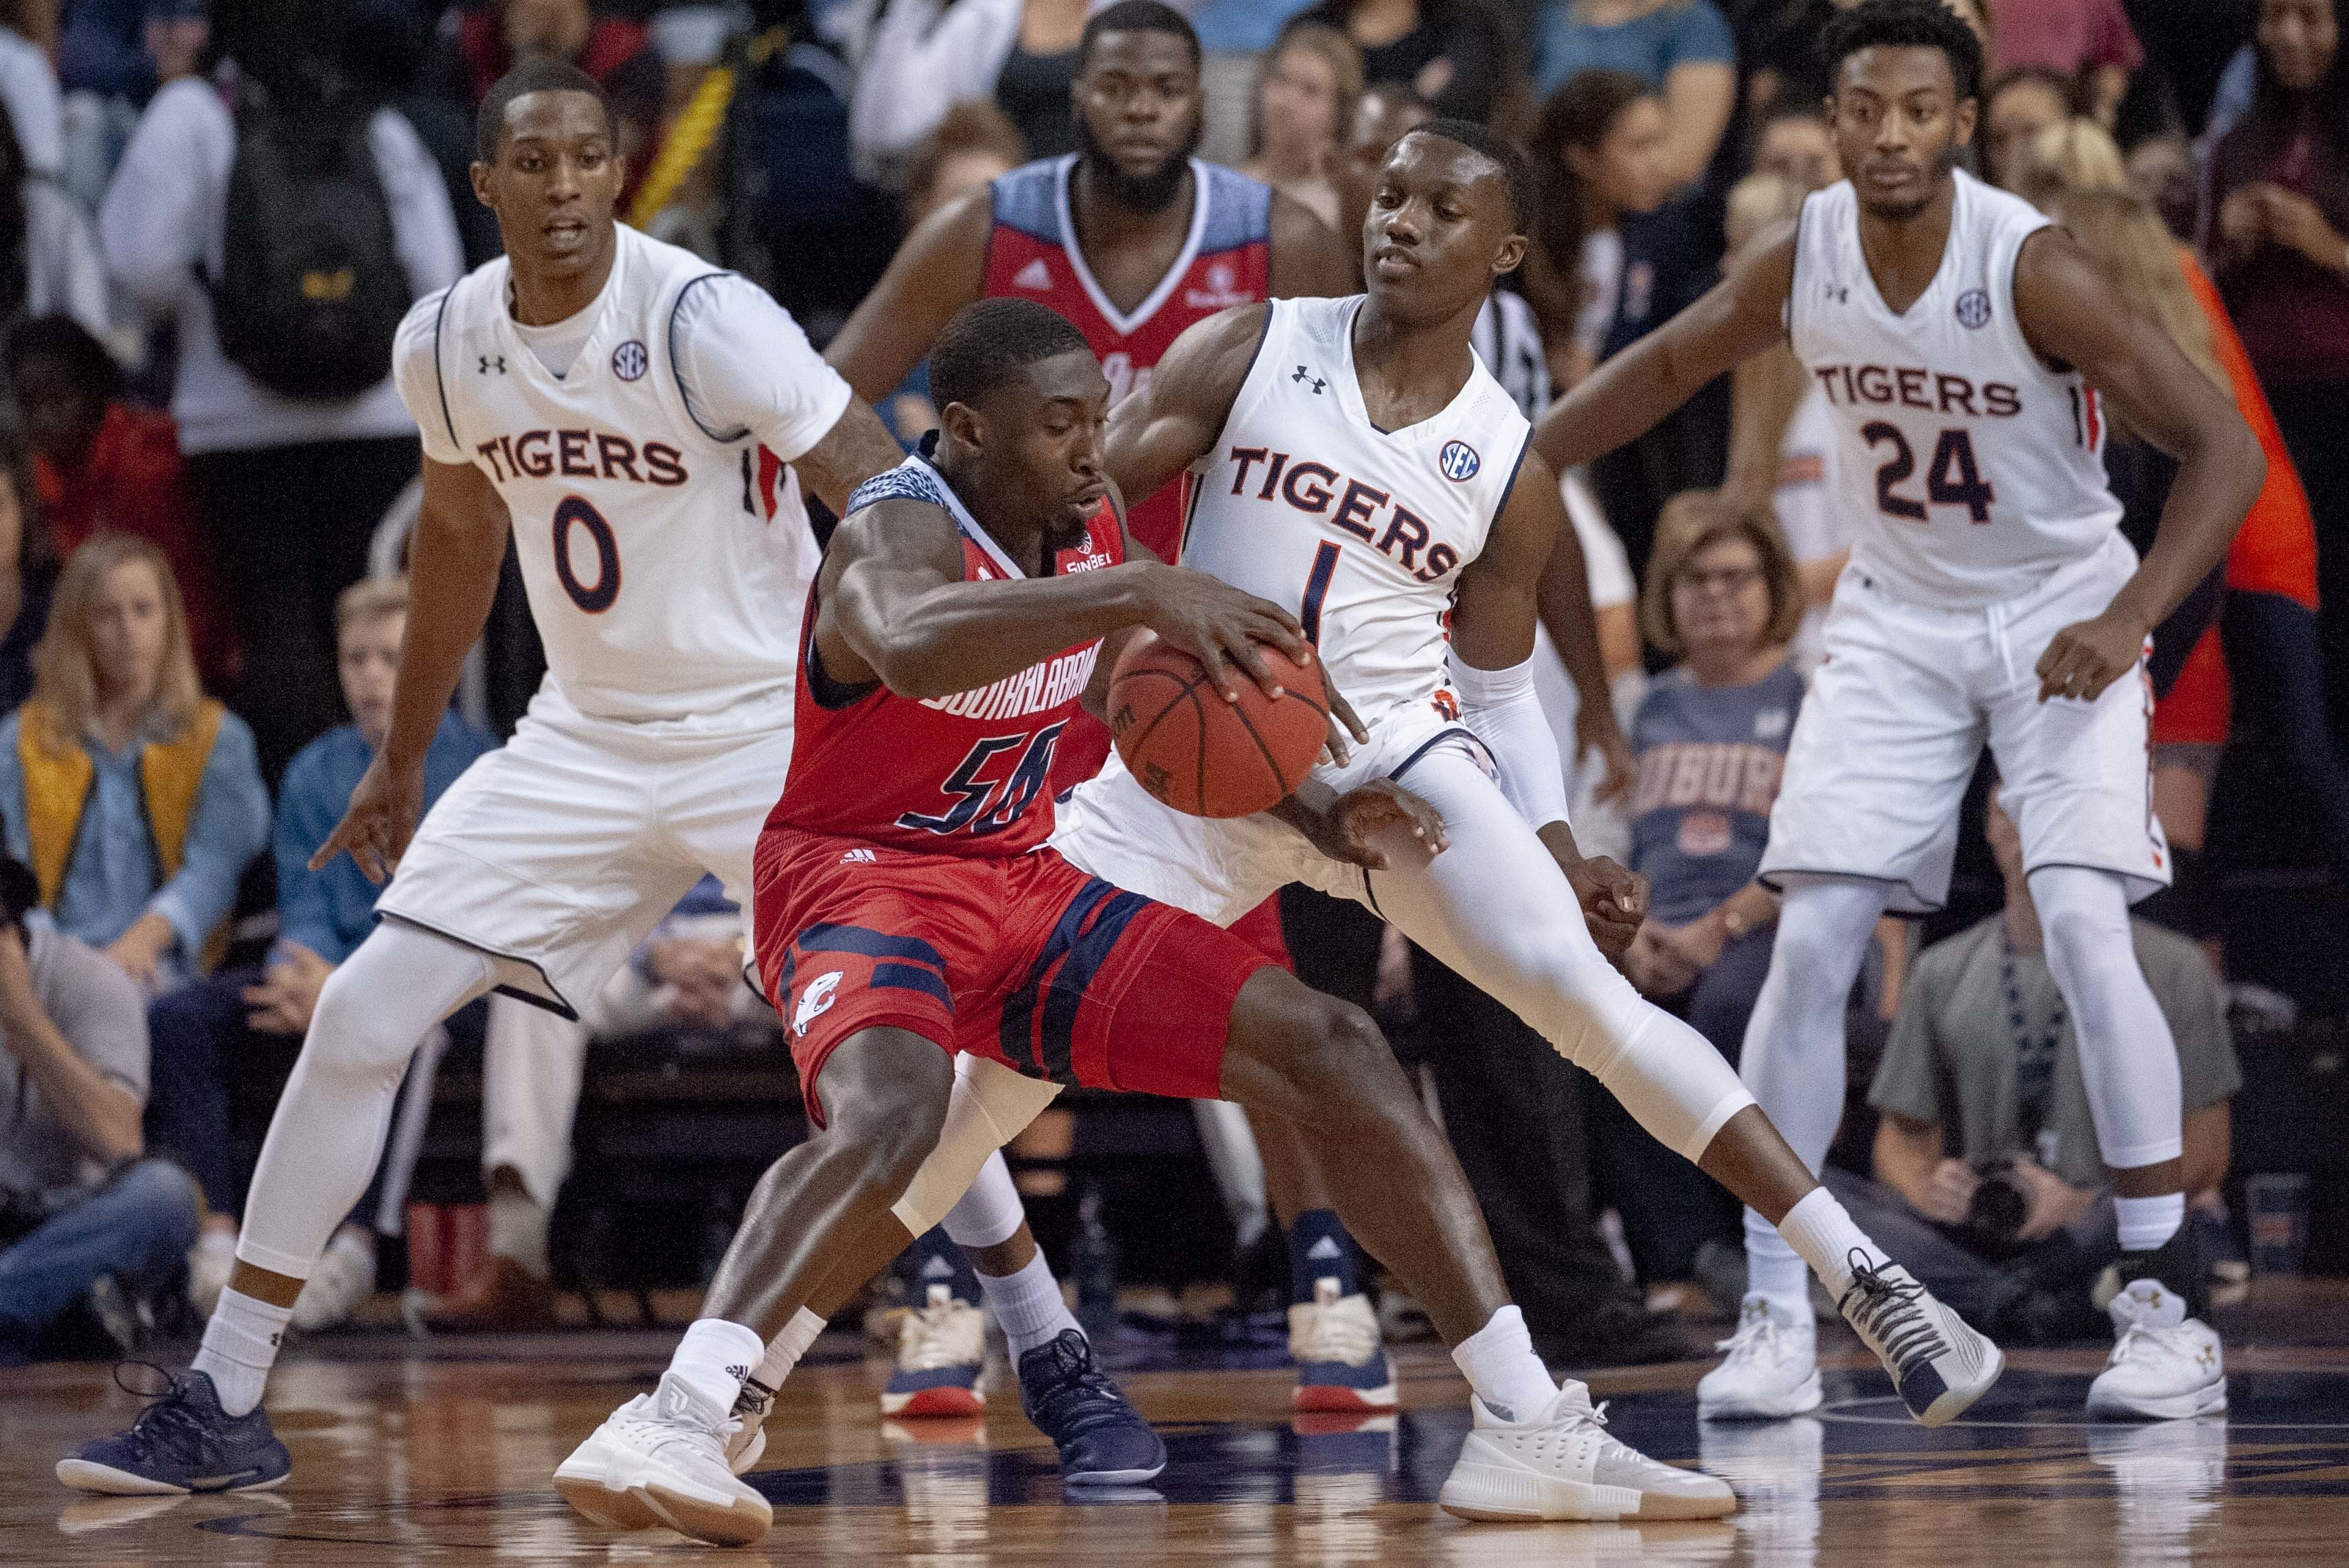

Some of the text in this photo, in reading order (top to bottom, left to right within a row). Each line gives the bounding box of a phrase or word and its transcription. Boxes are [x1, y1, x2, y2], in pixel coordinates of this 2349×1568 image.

[613, 341, 648, 381] SEC
[1816, 364, 2022, 417] TIGERS
[477, 429, 688, 486] TIGERS
[1440, 440, 1480, 482] SEC
[1860, 420, 1996, 525] 24
[1230, 446, 1459, 583] TIGERS
[553, 495, 622, 613] 0
[1301, 539, 1341, 651] 1
[1633, 742, 1785, 817] UBUR
